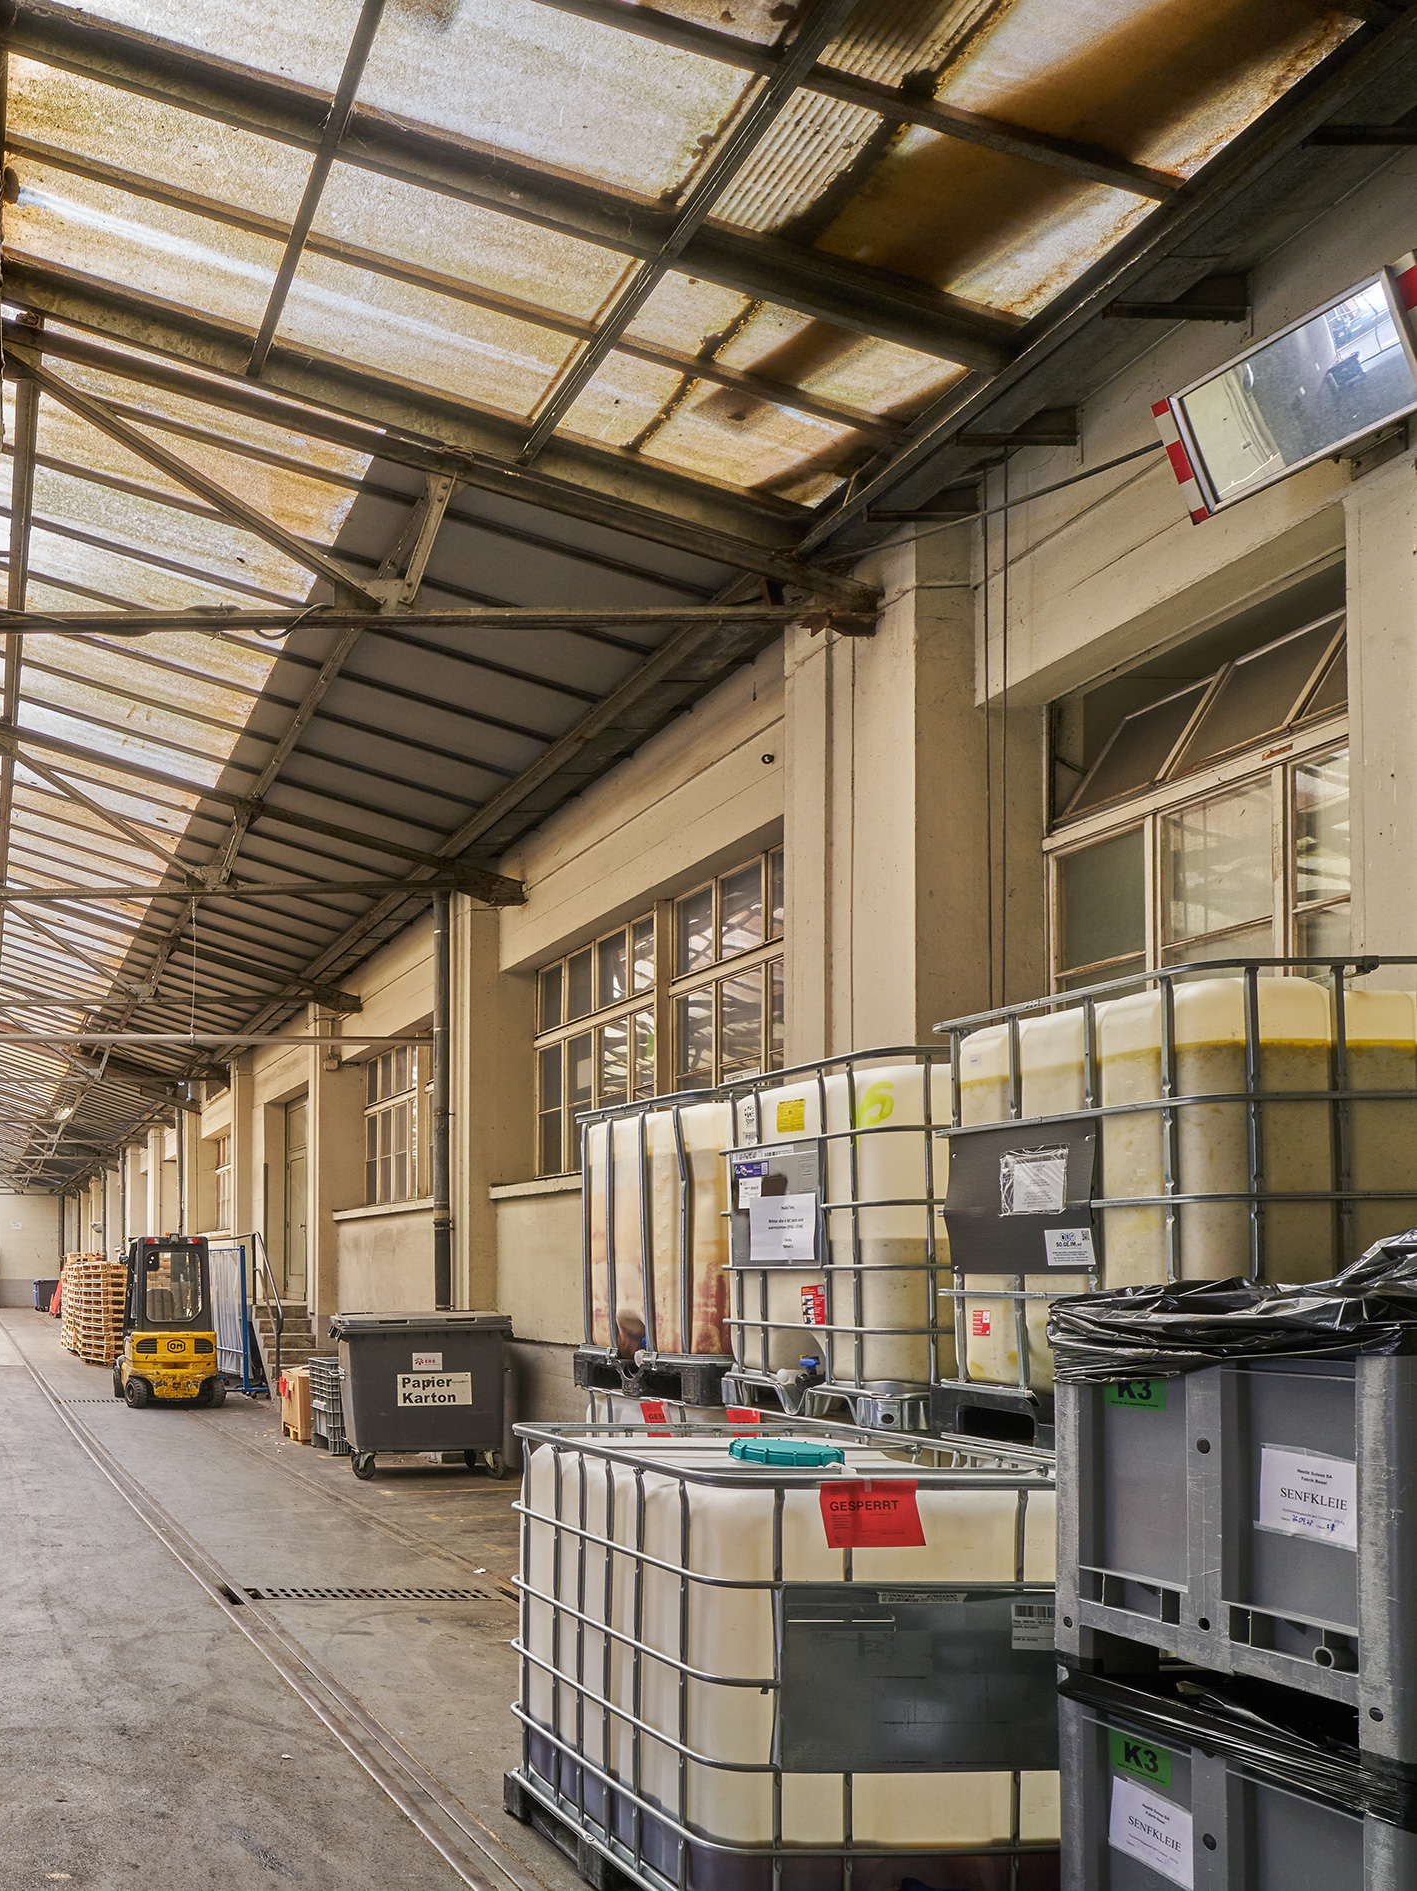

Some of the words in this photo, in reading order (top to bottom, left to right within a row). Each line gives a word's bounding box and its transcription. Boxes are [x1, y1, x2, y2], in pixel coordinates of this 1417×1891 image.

[860, 1081, 894, 1127] 6
[169, 1342, 183, 1350] OM
[402, 1376, 452, 1390] Papier
[1117, 1381, 1152, 1400] K3
[402, 1392, 456, 1404] Karton
[829, 1500, 899, 1512] GESPERRT
[1280, 1487, 1348, 1510] SENFKLEIE
[1124, 1741, 1159, 1773] K3
[1128, 1815, 1182, 1852] SENFKLEIE
